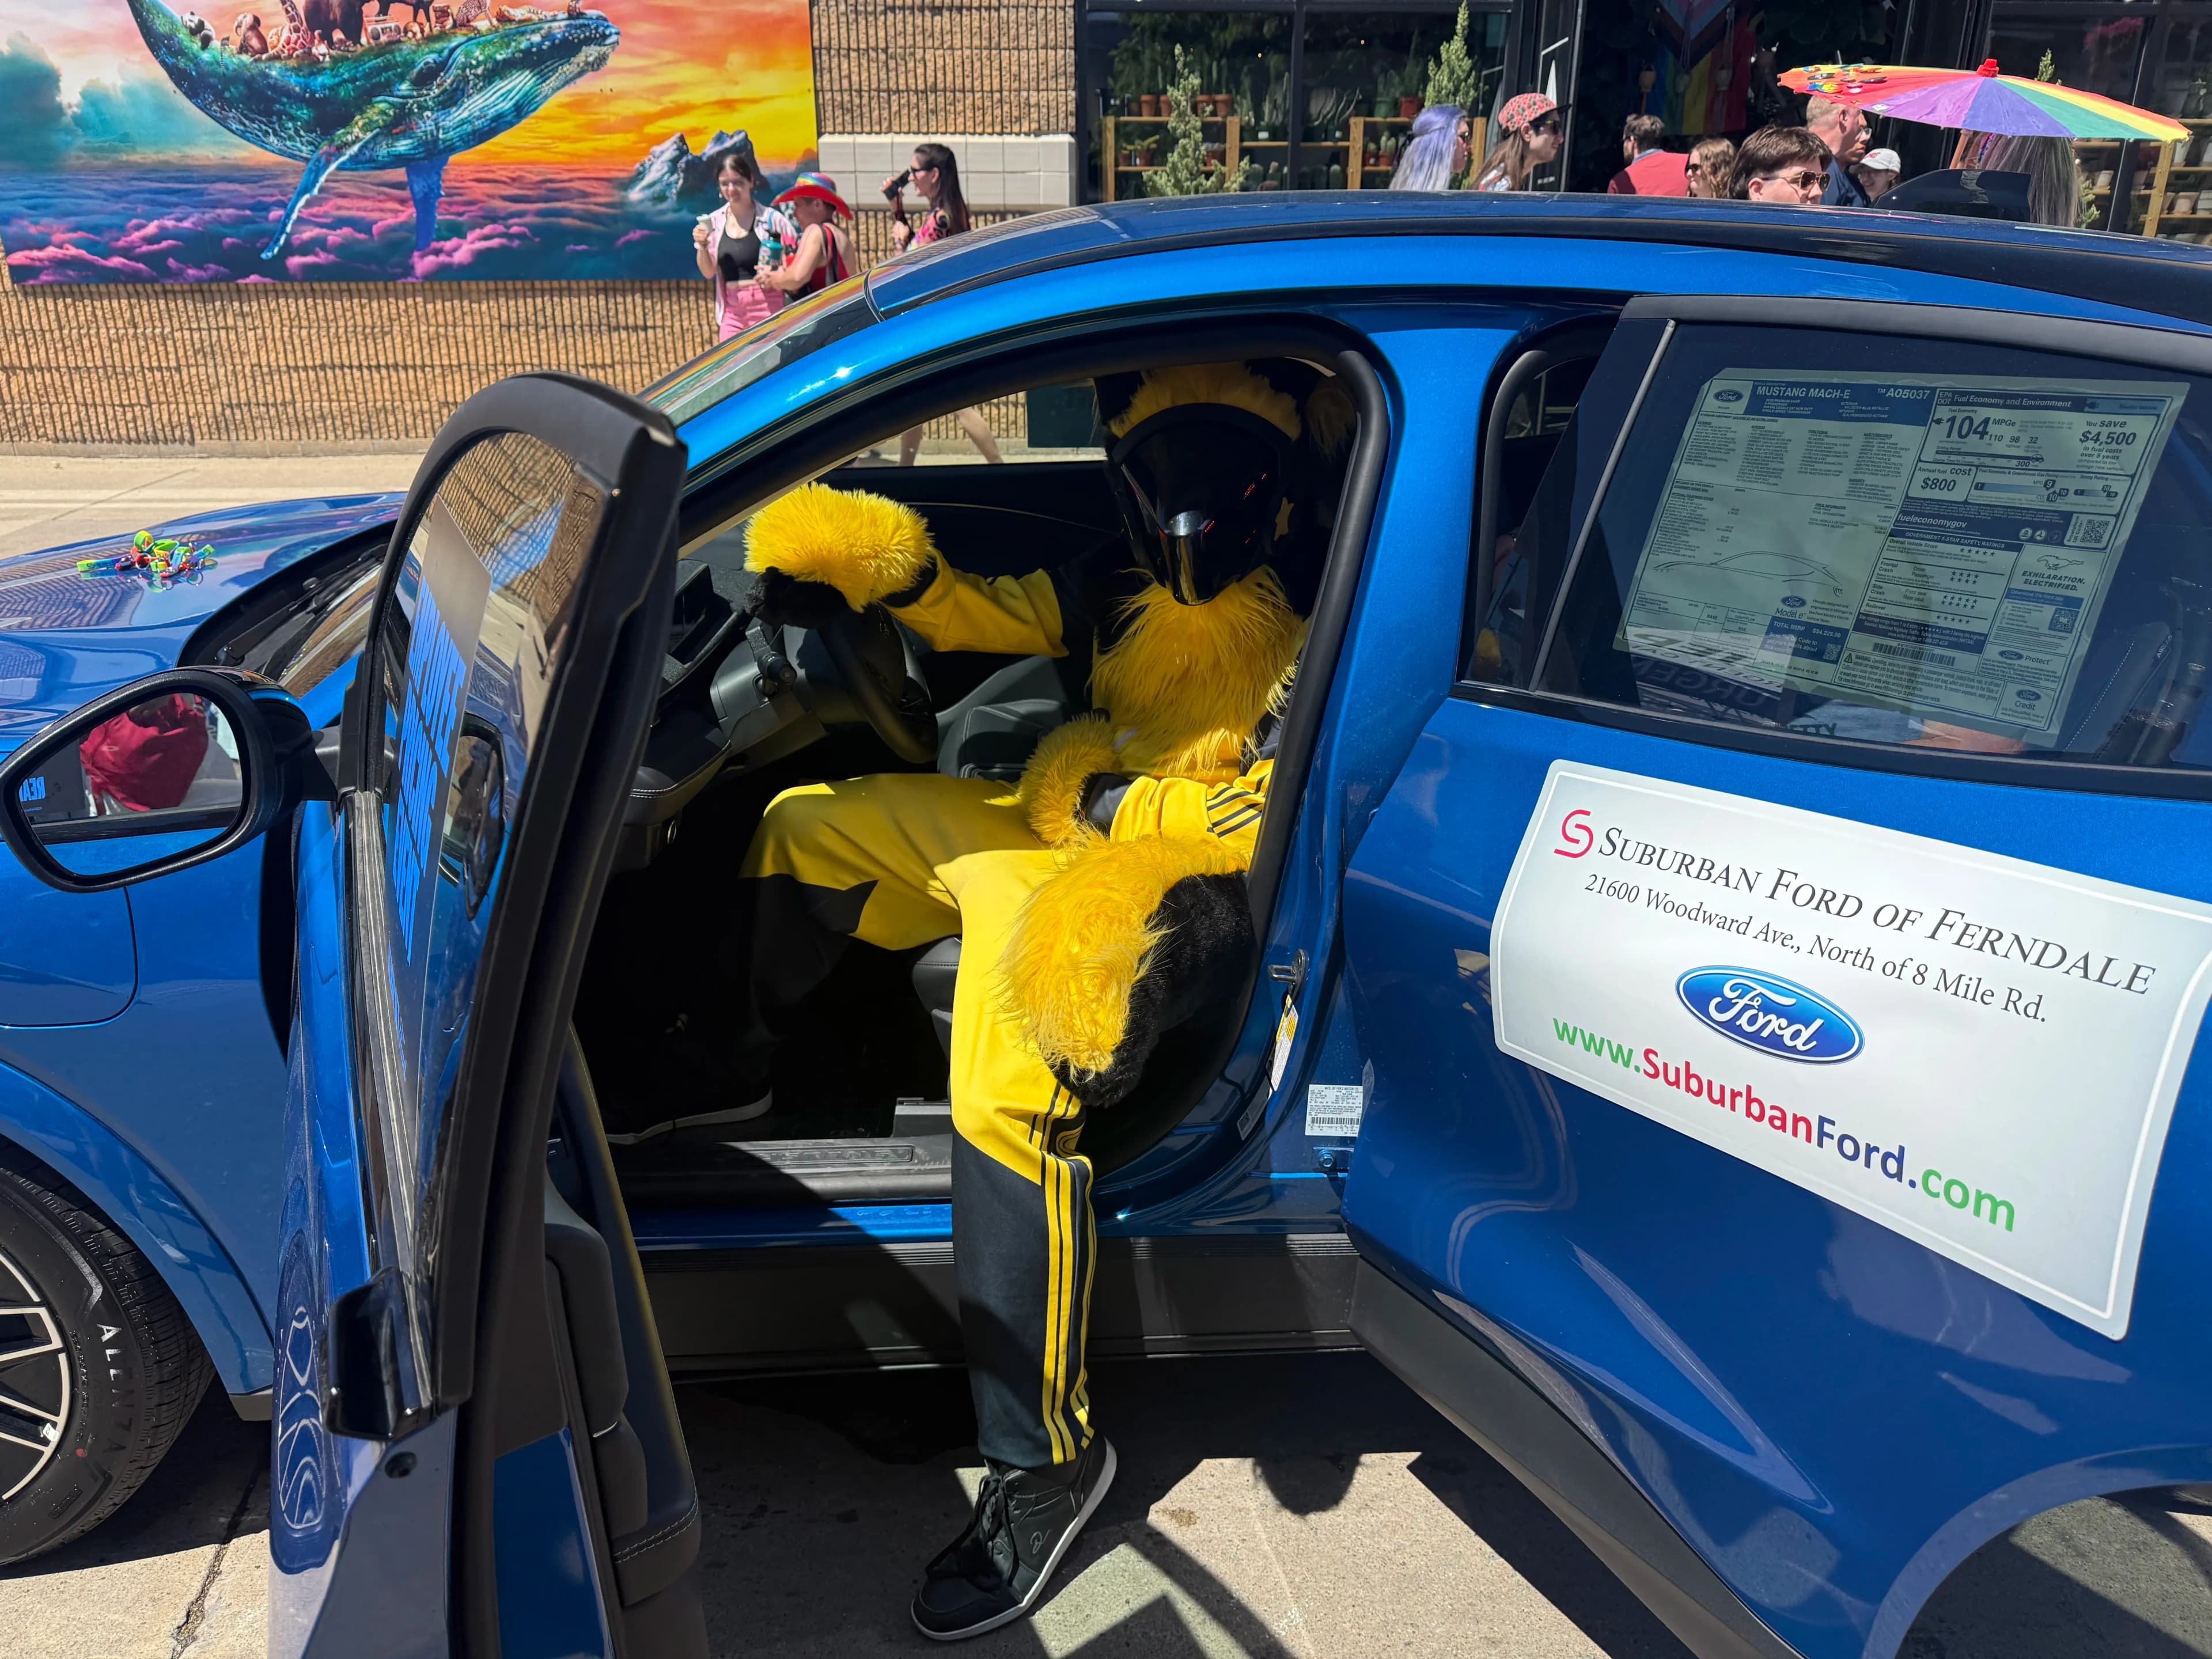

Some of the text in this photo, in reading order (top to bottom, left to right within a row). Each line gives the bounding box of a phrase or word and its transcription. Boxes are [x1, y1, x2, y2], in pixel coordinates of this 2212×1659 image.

[1757, 386, 1806, 396] MUSTANG
[1808, 388, 1851, 399] MACH-E
[1969, 395, 2004, 406] Economy
[2022, 398, 2071, 407] Environment
[1945, 415, 1991, 440] 104
[1992, 418, 2016, 427] MPGe
[2099, 420, 2127, 428] save
[1988, 434, 2003, 442] 110
[2079, 430, 2137, 446] $4,500
[1950, 468, 1972, 476] cost
[1921, 476, 1956, 492] $800
[1906, 532, 1941, 540] GOVERNMENT
[2022, 570, 2085, 584] EXHILARATION.
[2024, 578, 2078, 592] ELECTRIFIED.
[1775, 608, 1797, 618] Model
[1774, 621, 1790, 629] TOTAL
[1798, 637, 1811, 645] Code
[2025, 655, 2050, 665] Protect
[2015, 700, 2036, 710] Credit
[1765, 866, 1864, 920] FORD
[1872, 901, 1923, 937] OF
[1924, 907, 2157, 996] FERNDALE
[1584, 872, 2047, 1024] 21600 Woodward Ave., North of 8 Mile Rd.
[1708, 976, 1825, 1055] Ford
[1552, 1016, 2016, 1233] www.SuburbanFord.com
